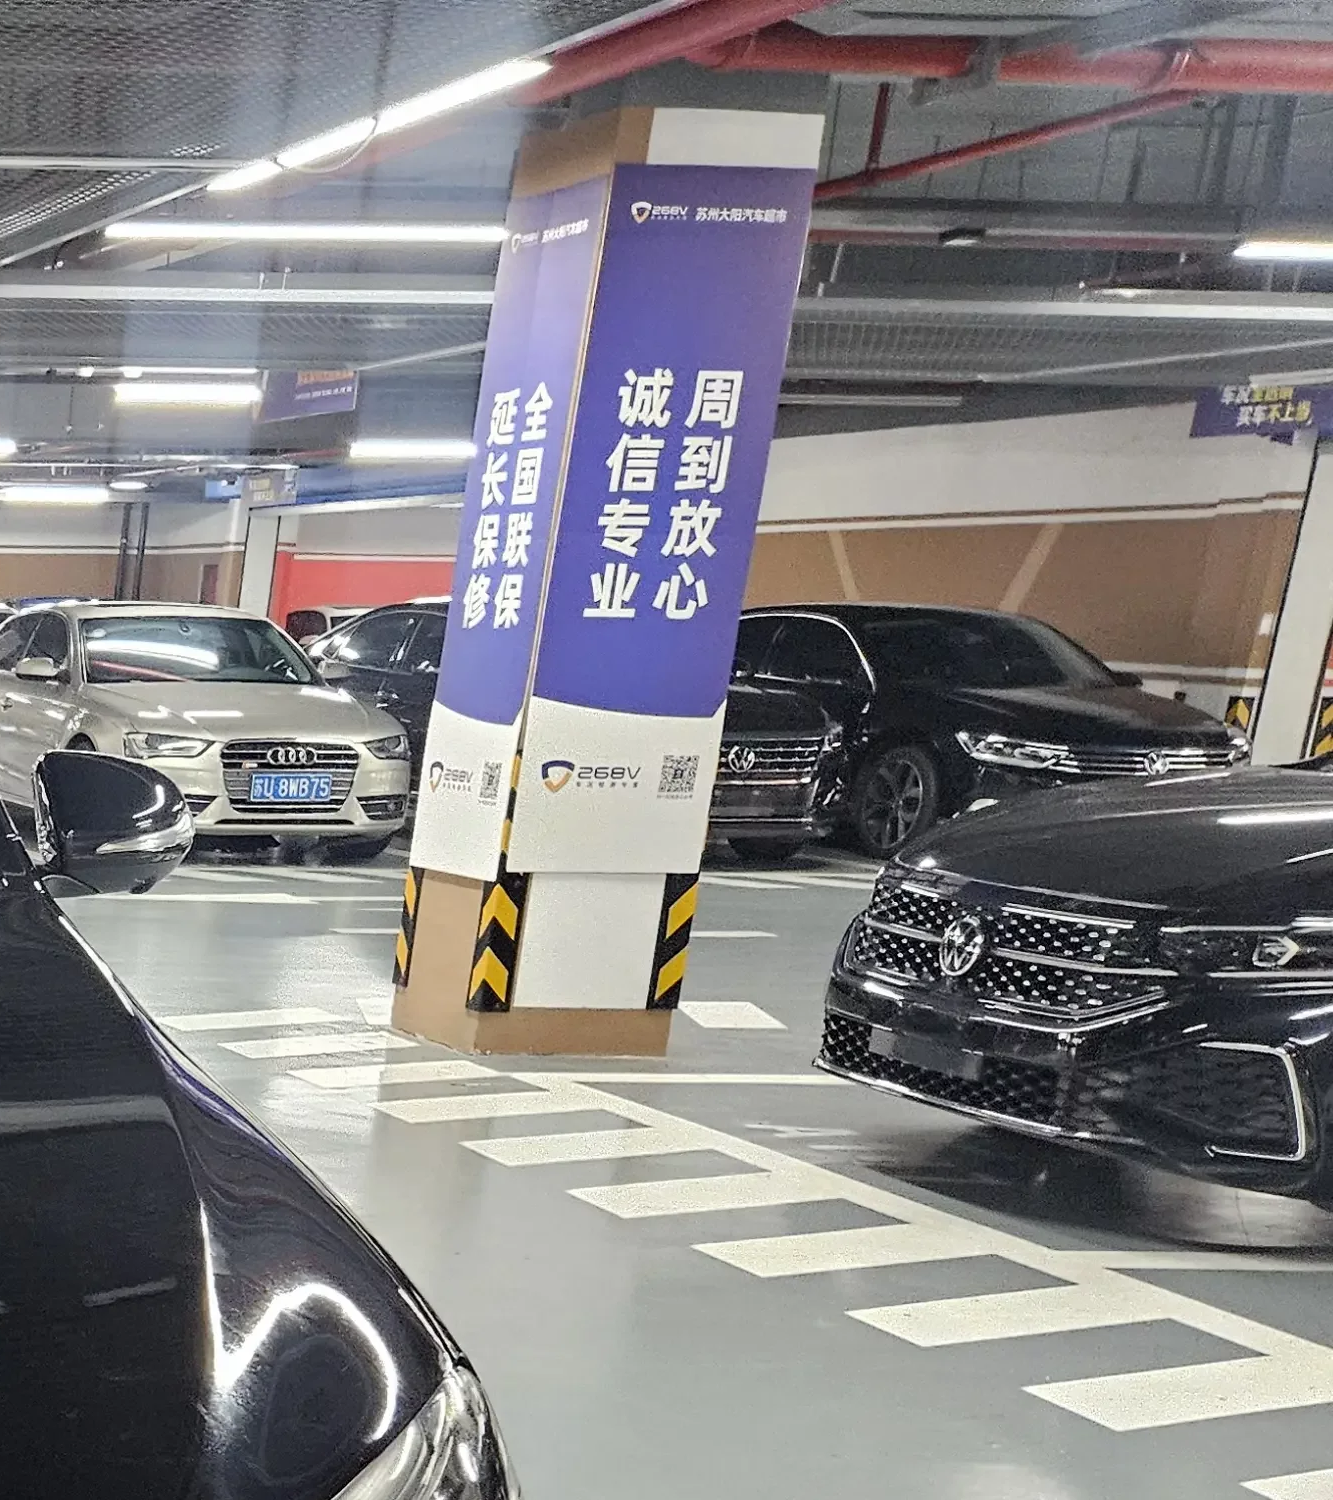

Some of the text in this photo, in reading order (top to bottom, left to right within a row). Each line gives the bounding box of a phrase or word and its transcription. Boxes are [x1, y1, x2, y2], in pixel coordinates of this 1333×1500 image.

[461, 387, 522, 631] 延长保修
[492, 381, 554, 630] 全国联保
[582, 369, 674, 619] 诚信专业
[652, 370, 745, 622] 周到放心
[577, 766, 642, 780] 268V
